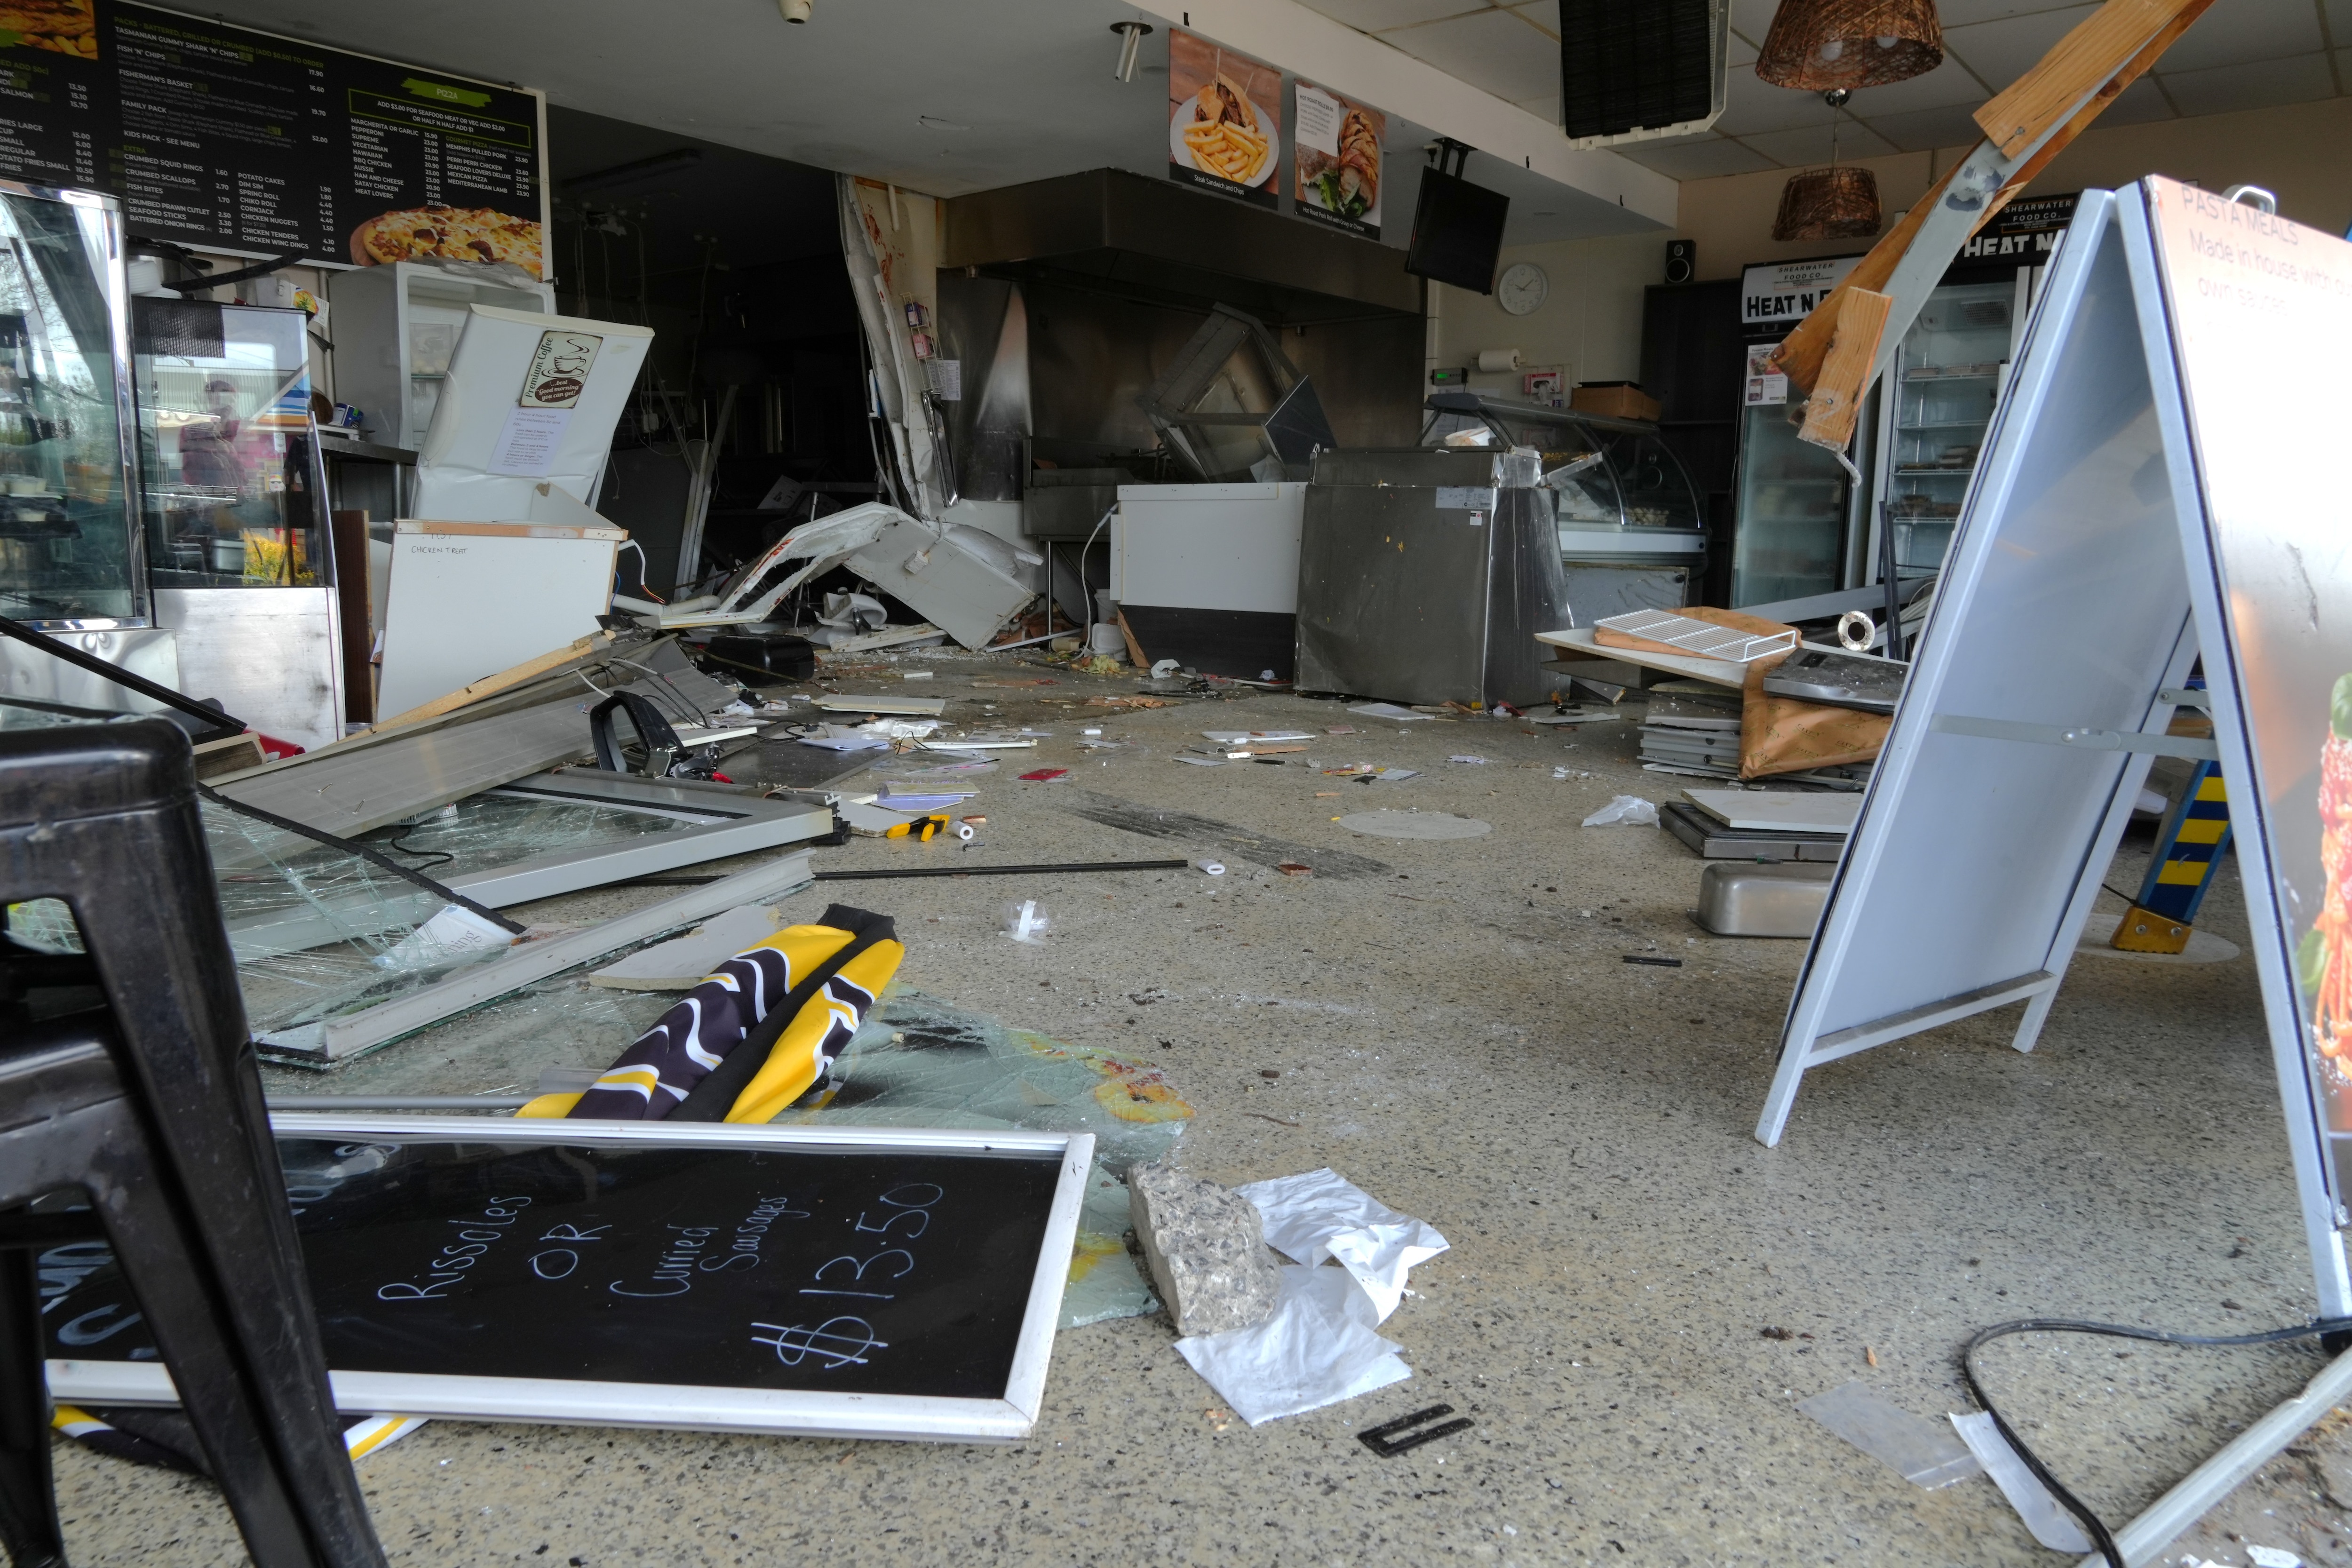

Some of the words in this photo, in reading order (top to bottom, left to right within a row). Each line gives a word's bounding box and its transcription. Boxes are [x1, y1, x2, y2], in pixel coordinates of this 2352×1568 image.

[114, 16, 138, 27] PACKS
[143, 23, 181, 37] BATTERED,
[182, 32, 210, 43] GRILLED
[222, 40, 254, 53] CRUMBED
[255, 48, 272, 56] (ADD
[273, 52, 292, 62] $0.50)
[302, 58, 324, 68] ORDER
[115, 26, 157, 41] TASMANIAN
[158, 36, 184, 47] GUMMY
[185, 42, 208, 52] SHARK
[219, 49, 239, 58] CHIPS
[309, 69, 323, 77] 17.90
[117, 44, 133, 53] FISH
[144, 50, 166, 60] CHIPS
[119, 69, 166, 83] FISHERMAN'S
[167, 79, 193, 89] BASKET
[437, 88, 458, 99] PIZZA
[70, 100, 88, 109] 15.70
[121, 99, 146, 109] FAMILY
[148, 104, 167, 113] PACK
[418, 109, 444, 119] SEAFOOD
[17, 121, 43, 132] LARGE
[72, 131, 90, 140] 15.00
[351, 125, 384, 136] PEPPERONI
[123, 144, 146, 154] EXTRA
[352, 141, 388, 152] VEGETARIAN
[353, 149, 382, 159] HAWAIIAN
[124, 153, 159, 164] CRUMBED
[159, 159, 182, 168] SQUID
[183, 163, 203, 172] RINGS
[76, 175, 94, 183] 15.90
[125, 168, 160, 179] CRUMBED
[161, 174, 196, 185] SCALLOPS
[446, 163, 471, 172] SEAFOOD
[492, 171, 511, 180] DELUXE
[143, 185, 163, 194] BITES
[1194, 175, 1206, 184] Steak
[1206, 178, 1225, 189] Sandwich
[1233, 186, 1244, 195] Chips
[239, 189, 262, 198] SPRING
[240, 205, 274, 215] CORNJACK
[2005, 200, 2071, 213] SHEARWATER
[240, 213, 269, 222] CHICKEN
[270, 217, 298, 226] NUGGETS
[2013, 214, 2040, 222] FOOD
[2181, 186, 2242, 223] PASTA
[2245, 208, 2299, 247] MEALS
[1340, 219, 1349, 228] Gravy
[1353, 223, 1365, 232] Cheese
[1964, 234, 2030, 257] HEAT
[2036, 232, 2053, 251] N
[2190, 228, 2234, 264] Made
[2237, 243, 2252, 270] in
[2253, 247, 2298, 282] house
[2300, 265, 2332, 291] with
[1779, 263, 1833, 273] SHEARWATER
[2198, 277, 2233, 300] own
[1747, 295, 1796, 318] HEAT
[1801, 293, 1813, 312] N
[524, 362, 543, 398] Premium
[537, 337, 553, 360] Coffee
[699, 1196, 810, 1273] Sausages
[377, 1195, 533, 1301] Rissoles
[529, 1223, 612, 1281] OR
[609, 1225, 720, 1298] Curried
